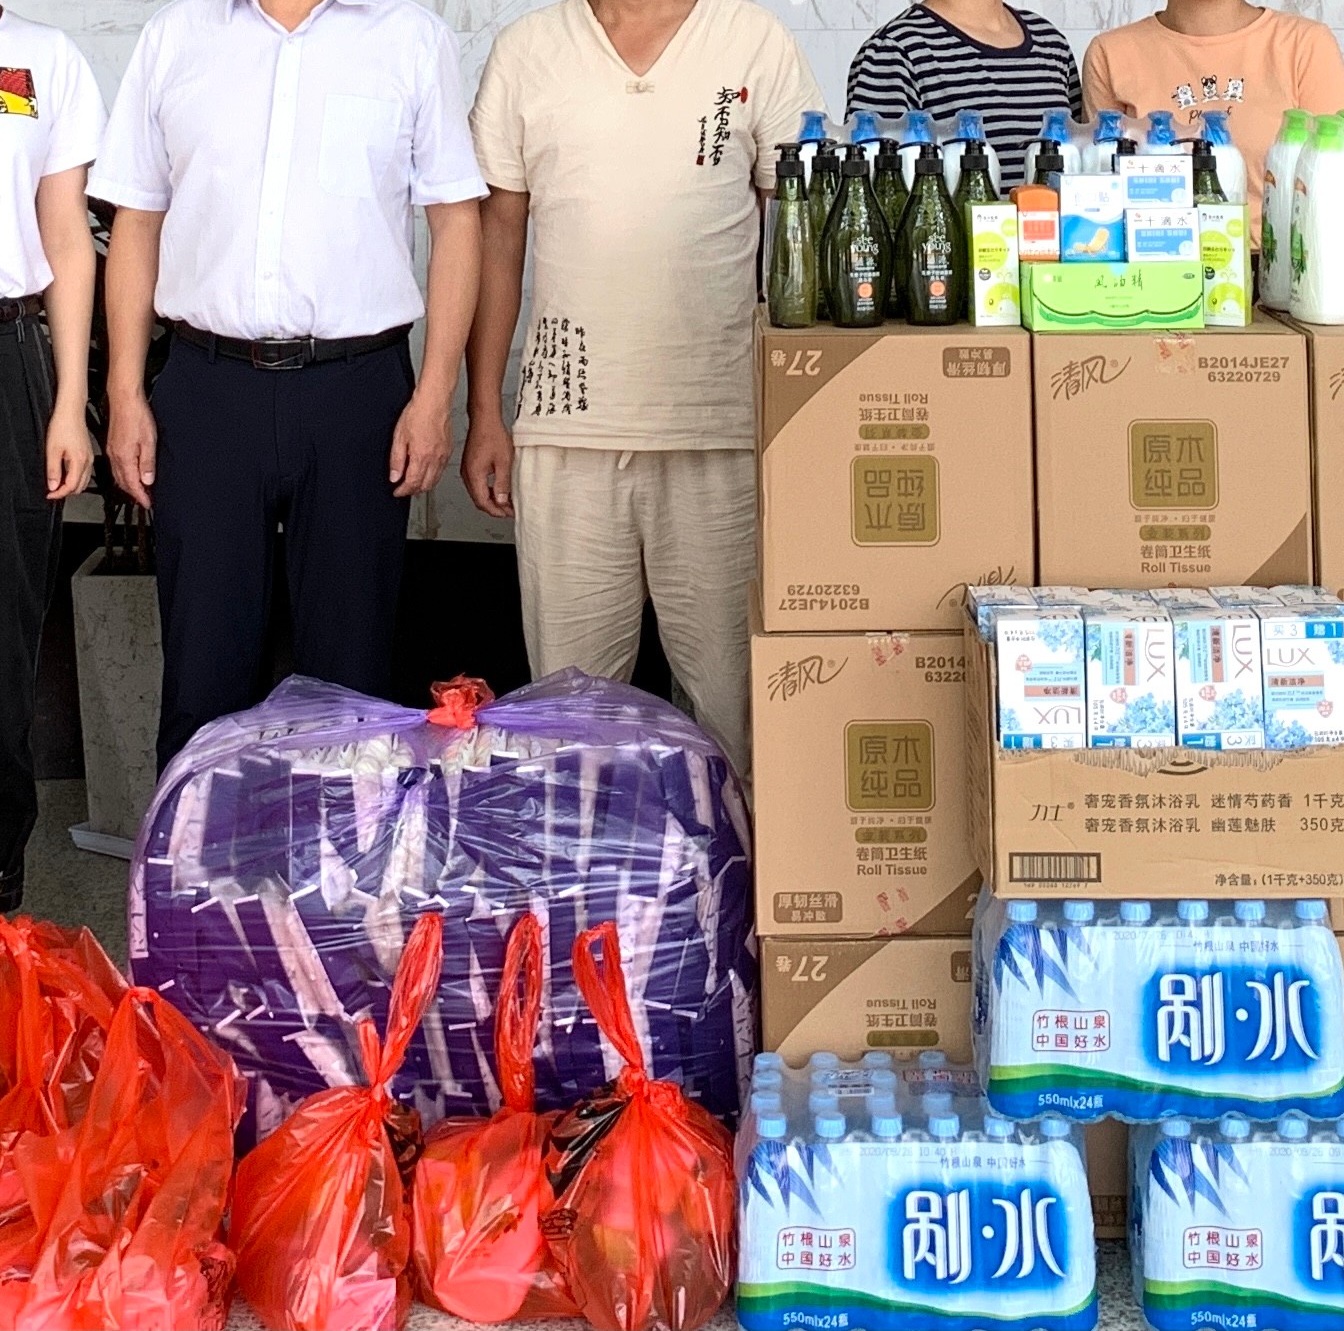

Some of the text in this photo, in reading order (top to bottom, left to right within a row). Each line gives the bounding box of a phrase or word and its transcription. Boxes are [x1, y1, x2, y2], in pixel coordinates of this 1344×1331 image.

[770, 349, 824, 377] 27卷
[945, 360, 1009, 377] 厚韧丝滑
[1198, 355, 1291, 370] B2014JE27
[1050, 355, 1132, 401] 清风
[1207, 370, 1282, 383] 63220729
[859, 392, 929, 405] Roll Tissue
[858, 407, 930, 422] 卷筒卫生纸
[1143, 434, 1205, 464] 原木
[864, 469, 925, 498] 纯品
[1143, 467, 1206, 497] 纯品
[864, 503, 926, 532] 原木
[1140, 544, 1212, 559] 卷筒卫生纸
[1141, 561, 1212, 573] Roll Tissue
[787, 584, 861, 595] 63220729
[778, 597, 870, 610] B2014JE27
[1144, 628, 1166, 683] LUX
[1231, 624, 1254, 679] LUX
[1266, 647, 1315, 668] LUX
[914, 655, 967, 669] B2014
[767, 655, 849, 702] 清风
[1033, 704, 1082, 725] LUX
[859, 735, 921, 765] 原木
[861, 768, 922, 798] 纯品
[1084, 793, 1201, 810] 奢宠香氛沐浴乳
[1210, 793, 1294, 809] 迷情芍药香
[1031, 803, 1067, 822] 力士
[1084, 817, 1201, 834] 奢宠香氛沐浴乳
[1211, 817, 1277, 834] 幽莲魅肤
[856, 846, 928, 861] 卷筒卫生纸
[856, 864, 928, 876] Roll Tissue
[778, 893, 839, 909] 厚韧丝滑
[775, 954, 829, 983] 27卷
[866, 998, 937, 1010] Roll Tissue
[865, 1013, 937, 1027] 卷筒卫生纸
[1036, 1014, 1106, 1031] 竹根山泉
[1036, 1033, 1106, 1050] 中国好水
[781, 1232, 852, 1249] 竹根山泉
[1187, 1230, 1260, 1250] 竹根山泉
[781, 1251, 853, 1267] 中国好水
[1187, 1250, 1260, 1268] 中国好水
